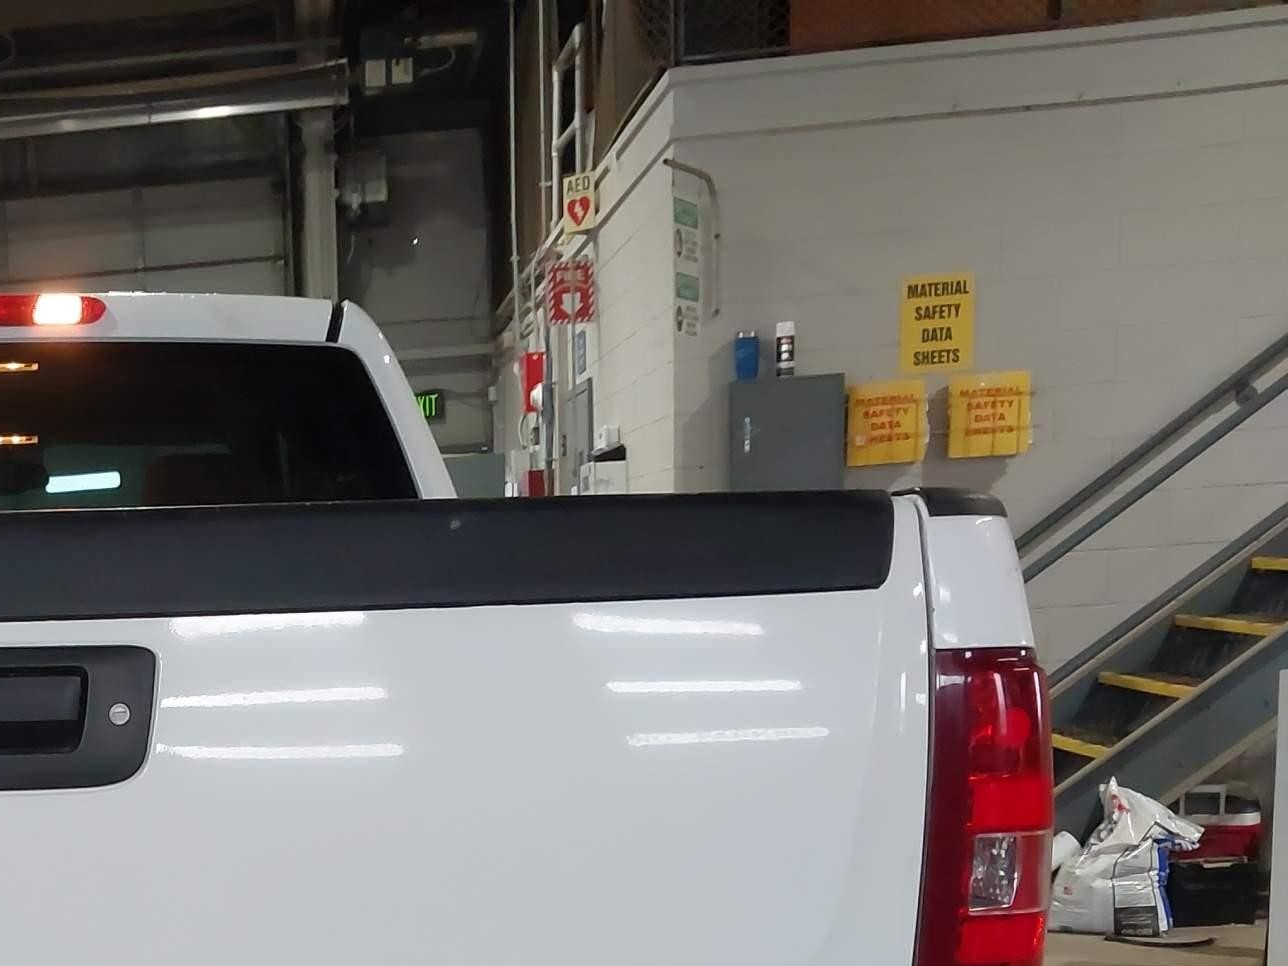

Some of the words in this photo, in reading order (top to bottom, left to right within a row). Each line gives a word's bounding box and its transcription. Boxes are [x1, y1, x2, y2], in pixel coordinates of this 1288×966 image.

[566, 175, 591, 195] AED
[907, 280, 970, 299] MATERIAL
[914, 303, 961, 321] SAFETY
[921, 326, 953, 343] DATA
[913, 348, 960, 366] SHEETS
[863, 407, 910, 419] SAFETY
[967, 399, 1014, 411] SAFETY
[871, 420, 902, 431] DATA
[974, 413, 1006, 423] DATA
